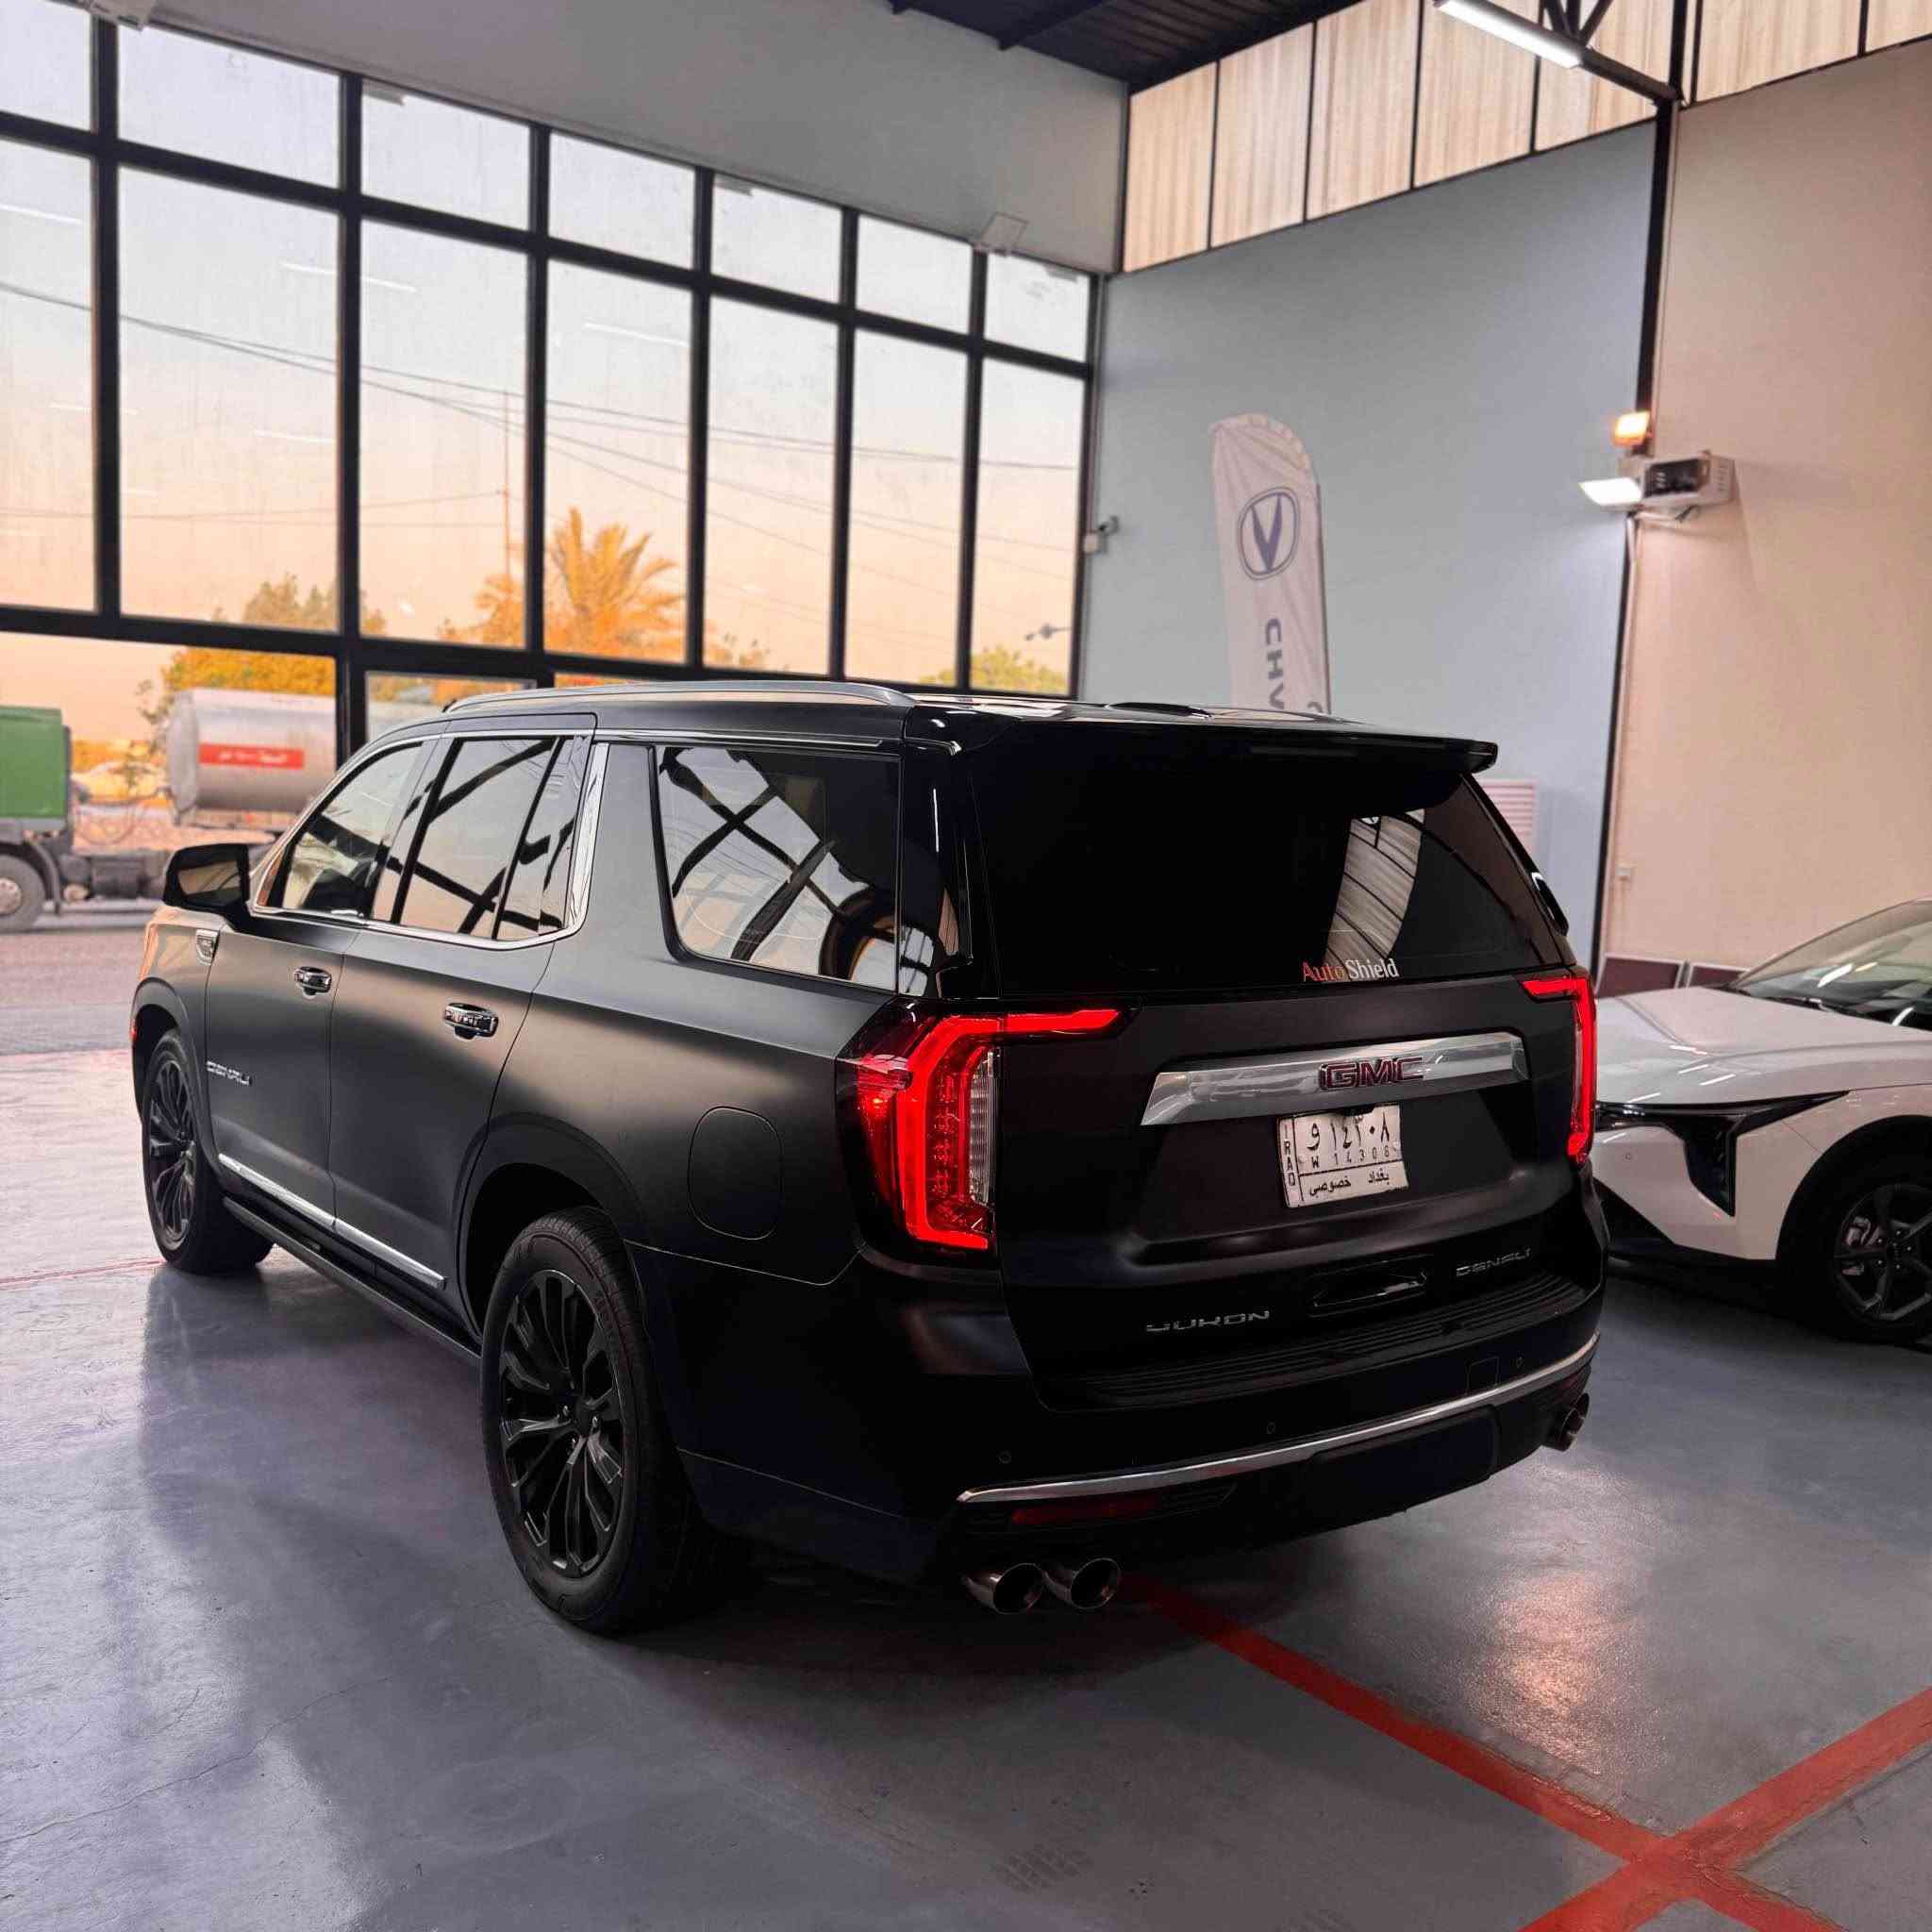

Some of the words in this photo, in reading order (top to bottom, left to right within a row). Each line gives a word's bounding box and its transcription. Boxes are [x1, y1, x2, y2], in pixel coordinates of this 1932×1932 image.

[1320, 1056, 1424, 1091] GMC
[1311, 1156, 1320, 1169] W
[1309, 1175, 1352, 1198] خصوصي
[1368, 1168, 1390, 1185] بغداد
[1456, 1248, 1532, 1276] DENALI
[1145, 1310, 1271, 1333] YUKON
